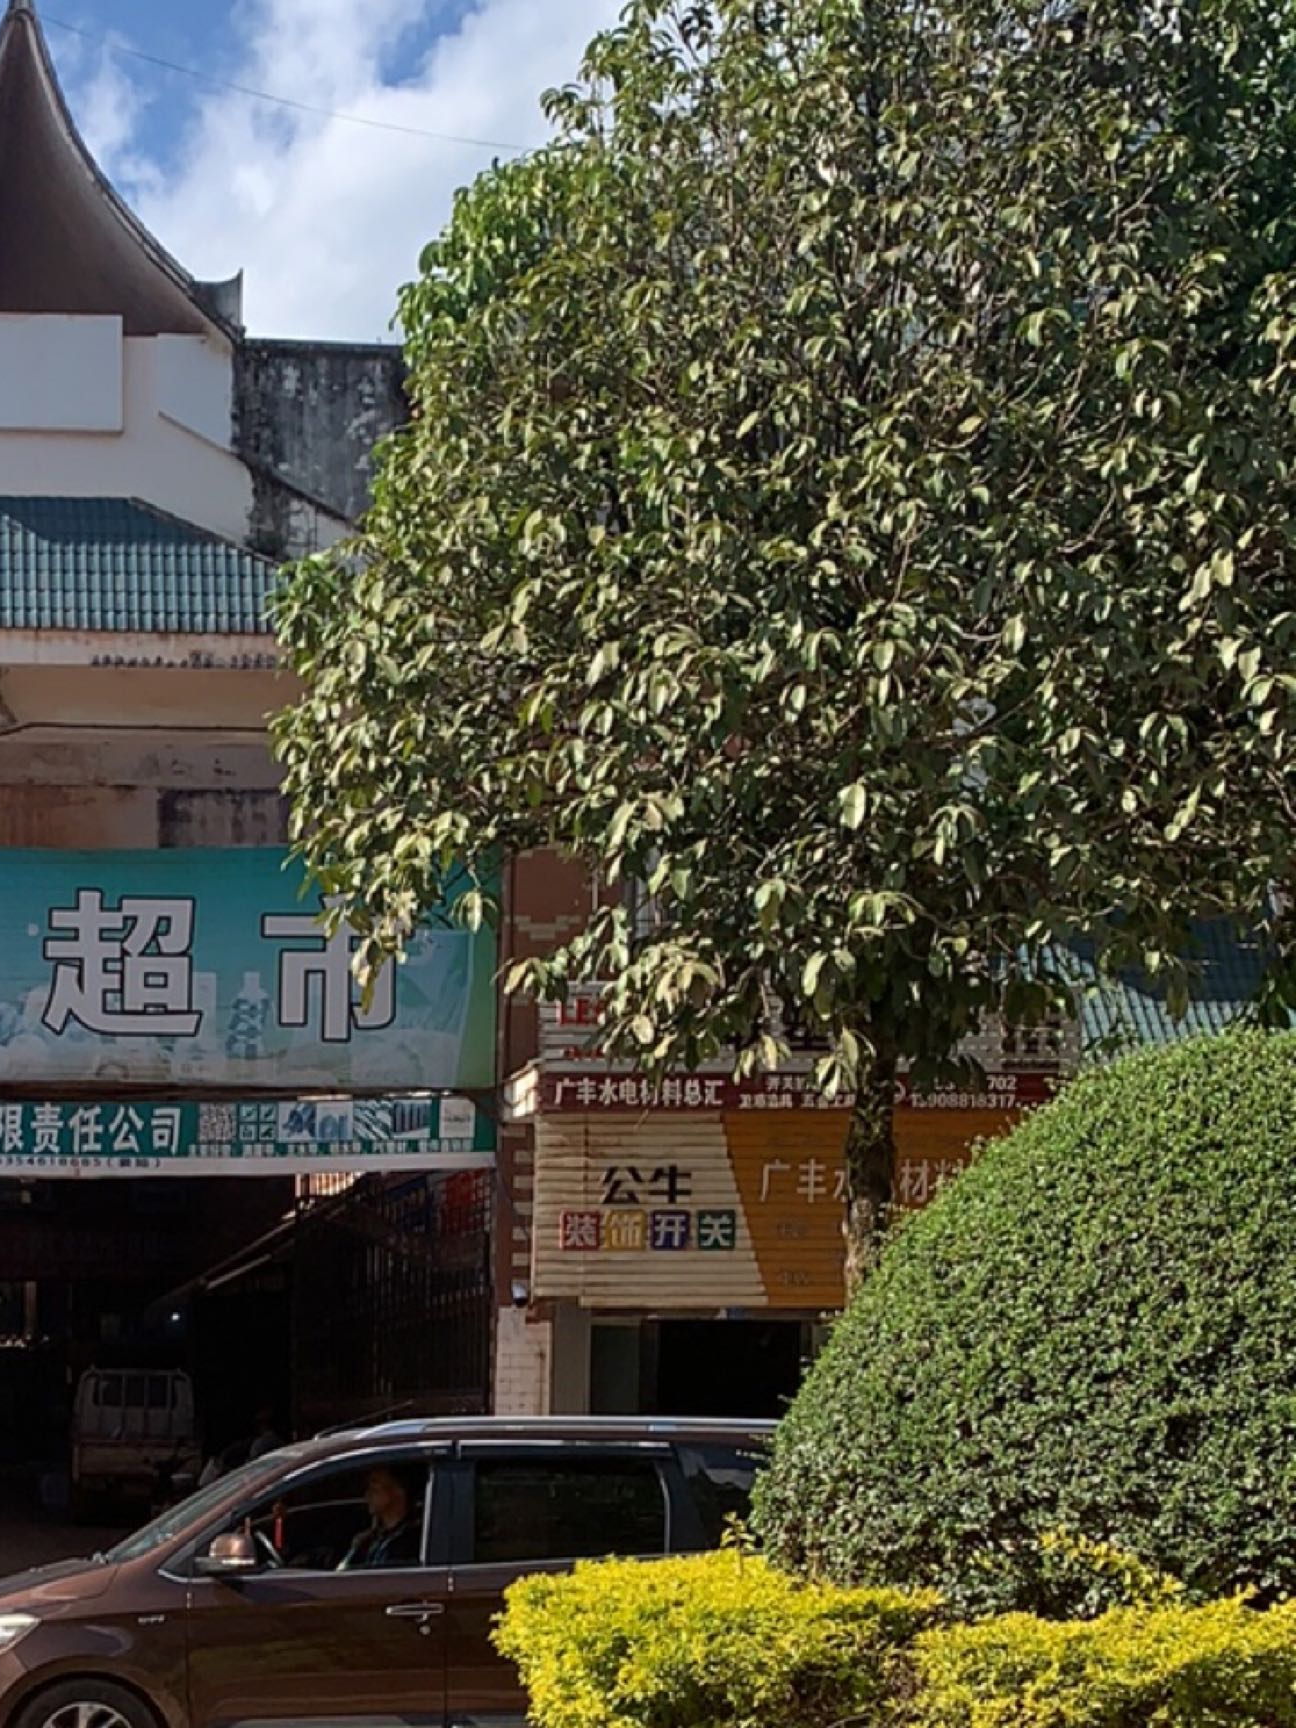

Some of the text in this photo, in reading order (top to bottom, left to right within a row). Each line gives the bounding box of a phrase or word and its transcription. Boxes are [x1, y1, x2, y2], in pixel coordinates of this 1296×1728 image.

[601, 1164, 692, 1204] 公牛
[759, 1157, 964, 1204] 广丰水材料
[563, 1211, 734, 1249] 装饰开关
